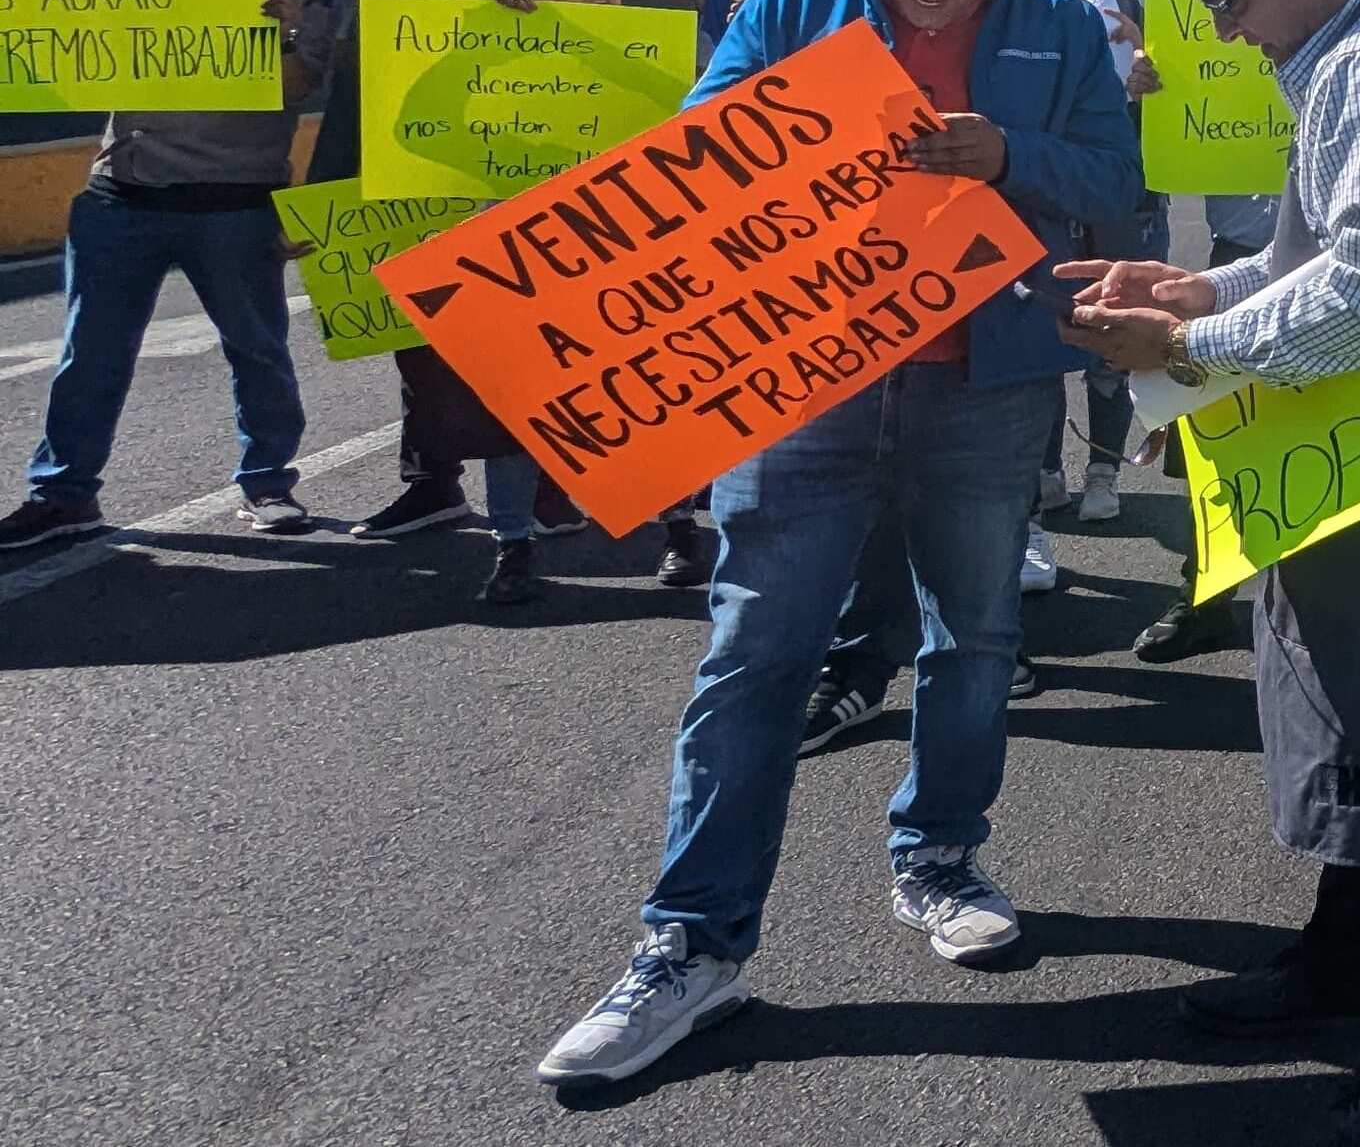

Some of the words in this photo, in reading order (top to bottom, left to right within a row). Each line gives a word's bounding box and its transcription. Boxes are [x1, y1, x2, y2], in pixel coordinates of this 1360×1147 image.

[126, 26, 277, 81] TRABAJO!!!
[394, 15, 594, 54] Autoridades
[624, 40, 658, 60] en
[467, 65, 603, 95] diciembre
[1199, 60, 1240, 80] nos
[404, 118, 450, 139] nos
[469, 111, 552, 144] quitan
[579, 115, 598, 137] el
[457, 76, 832, 299] VENIMOS
[538, 323, 594, 368] A
[598, 257, 715, 336] QUE
[710, 200, 818, 273] NOS
[528, 227, 909, 475] NECESITAMOS
[693, 270, 955, 438] TRABAJO
